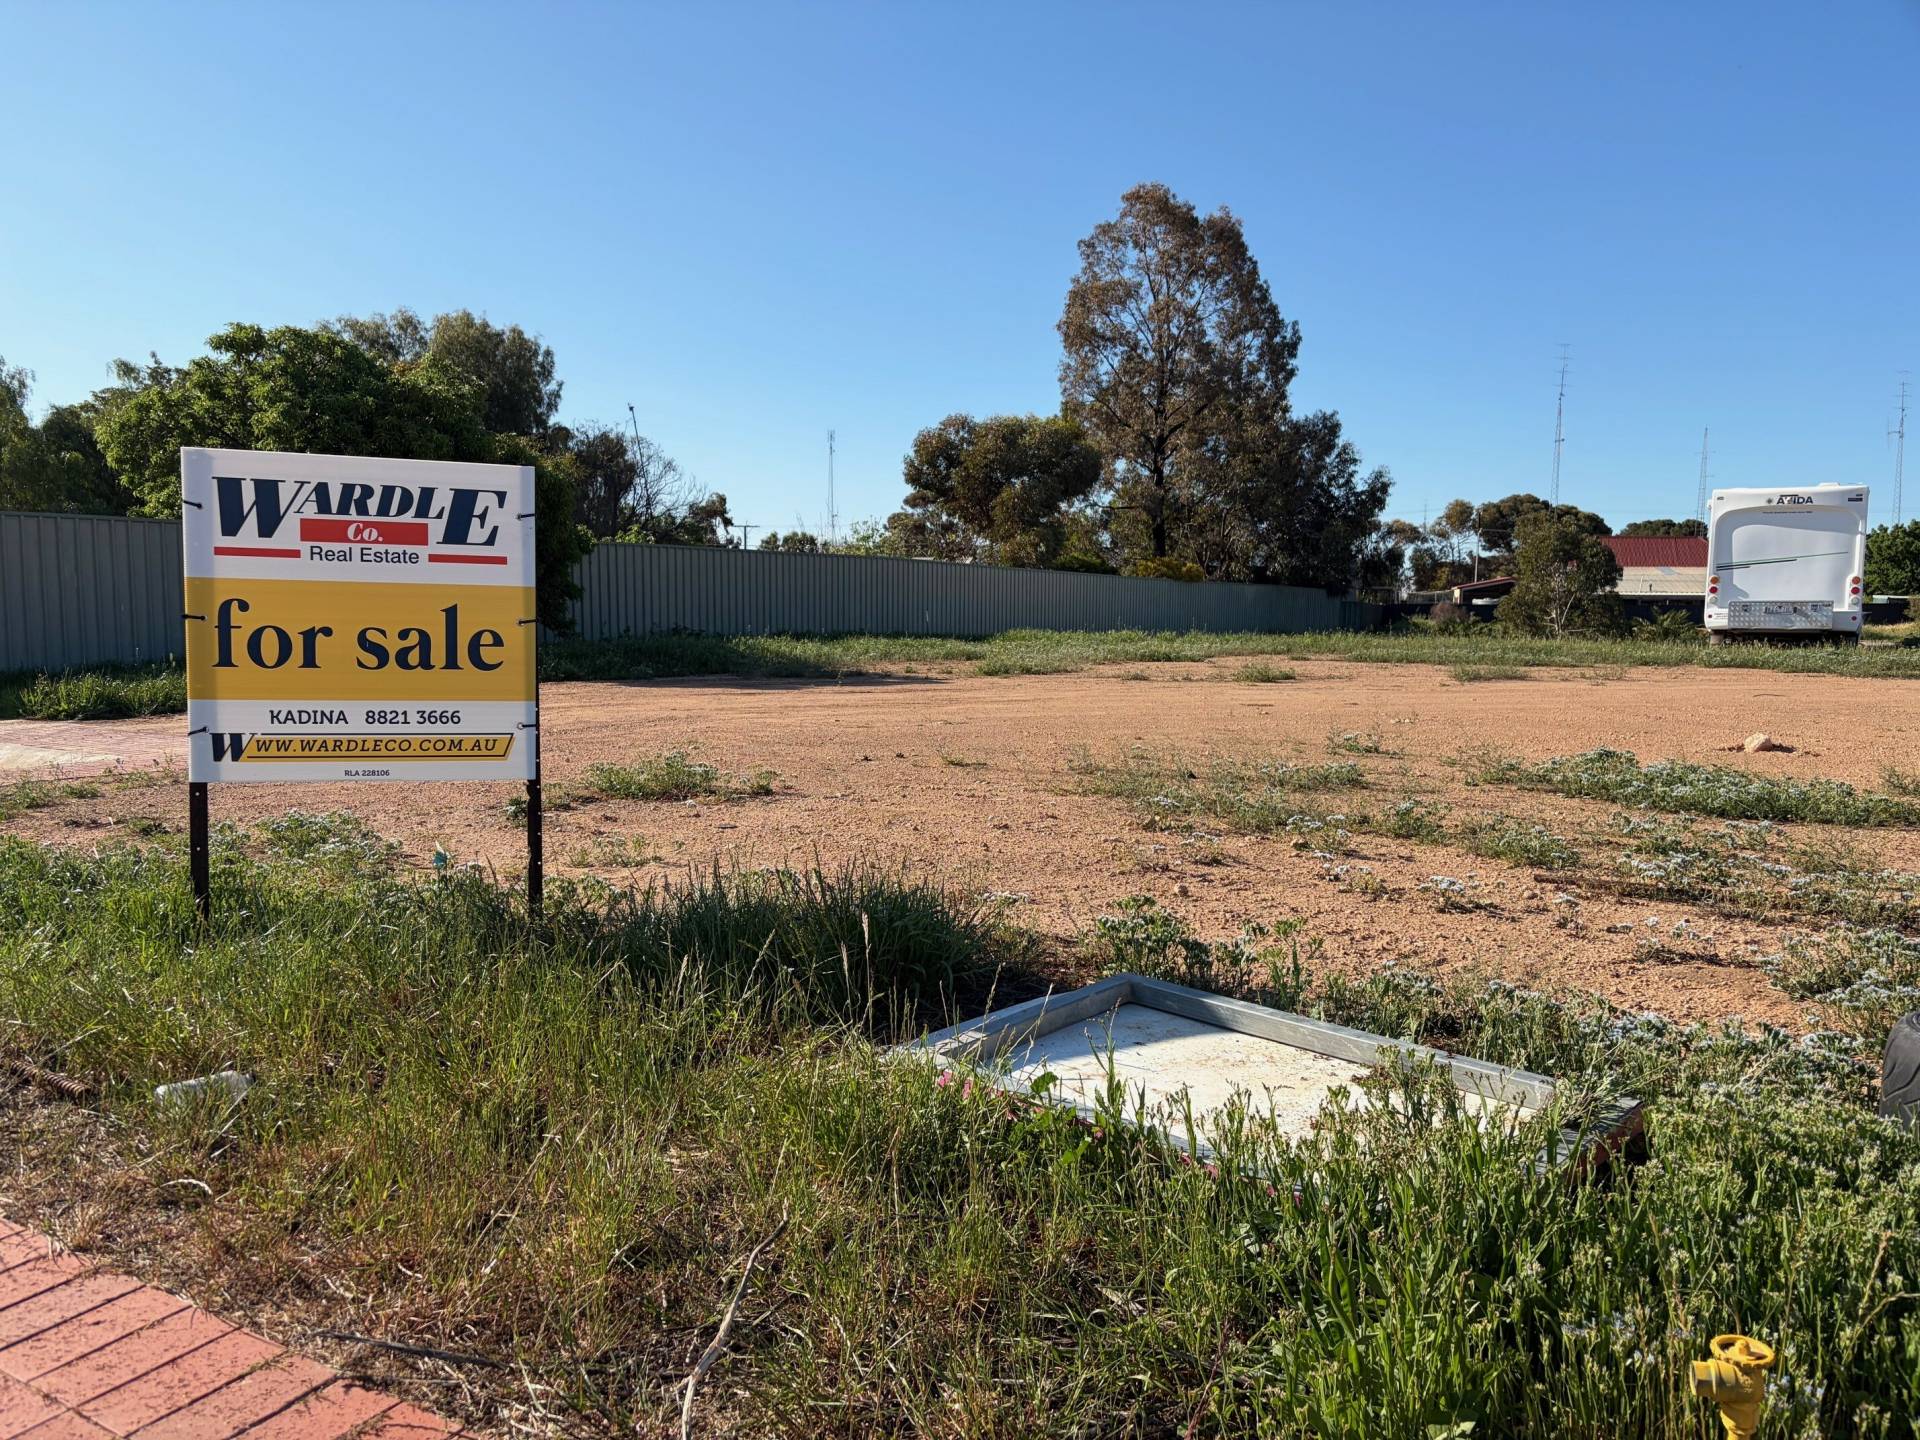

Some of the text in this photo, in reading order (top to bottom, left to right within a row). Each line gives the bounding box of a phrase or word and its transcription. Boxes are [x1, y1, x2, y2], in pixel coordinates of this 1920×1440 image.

[211, 476, 507, 546] WARDLE
[347, 522, 383, 542] Co.
[309, 545, 420, 564] Real Estate
[211, 598, 504, 671] for sale
[269, 709, 461, 725] KADINA 8821 3666
[209, 732, 498, 762] WWW.WARDLECO.COM.AU
[344, 769, 390, 777] RLA 228106
